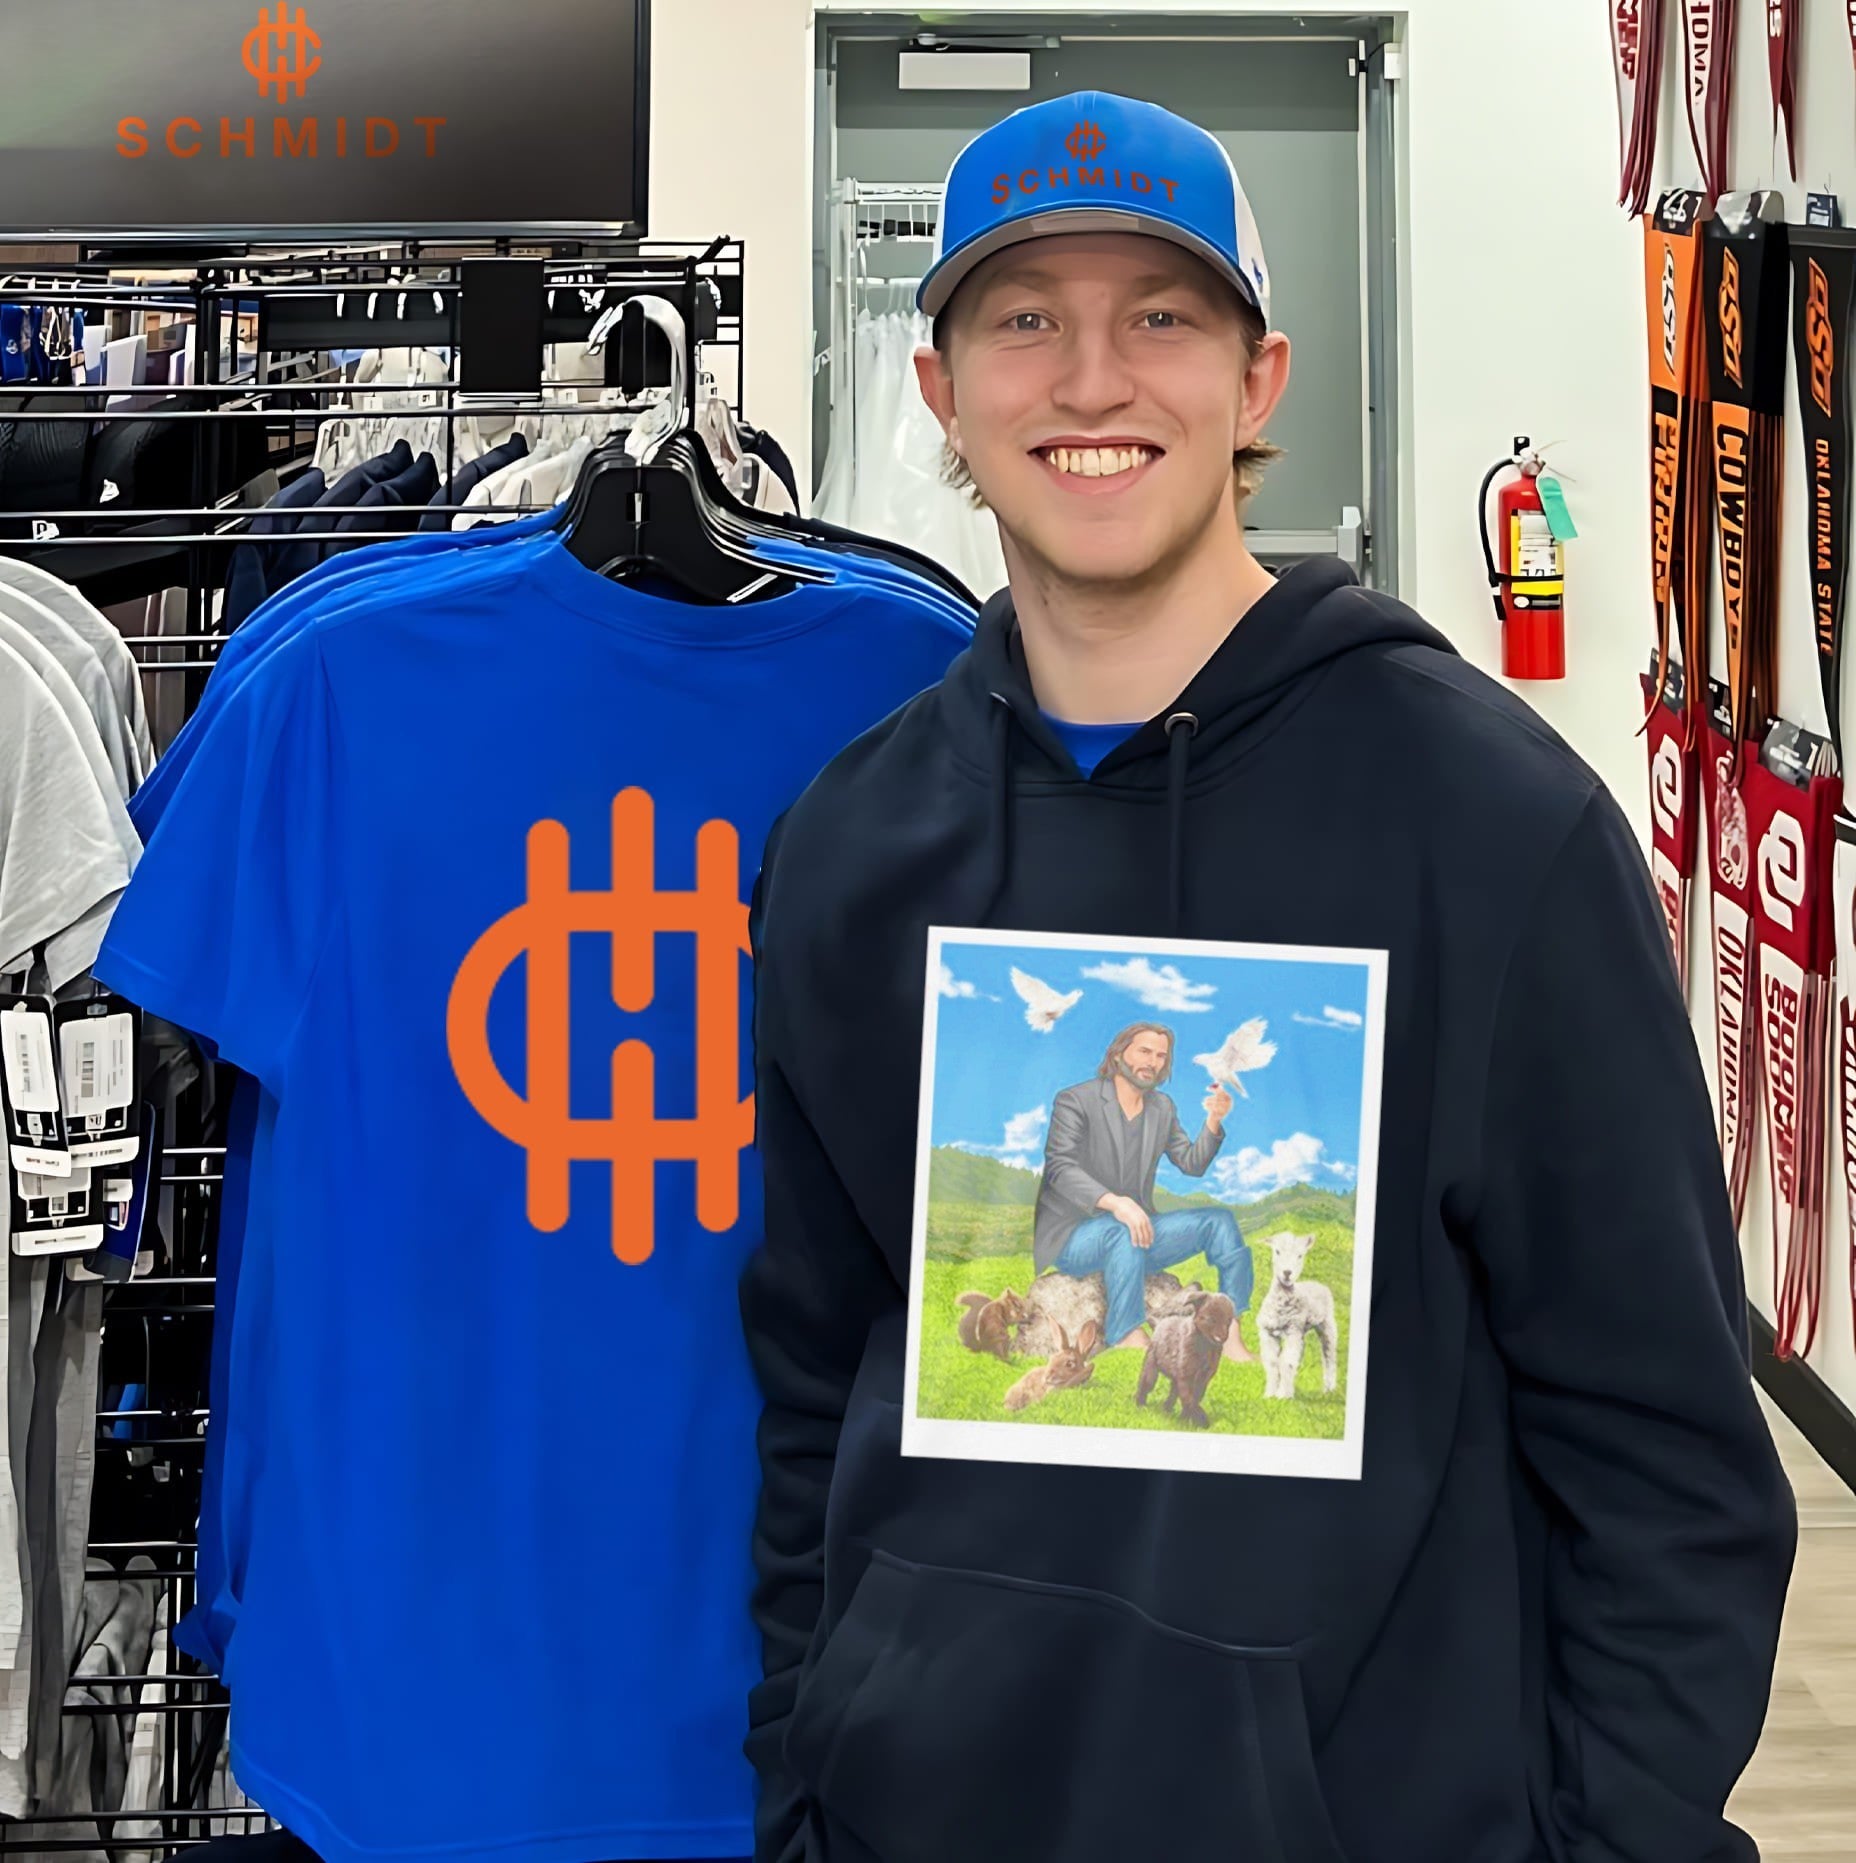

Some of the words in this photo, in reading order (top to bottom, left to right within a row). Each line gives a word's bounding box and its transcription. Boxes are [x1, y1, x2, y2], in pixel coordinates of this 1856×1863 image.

[115, 116, 448, 159] SCHMIDT
[991, 166, 1179, 204] SCHMIDT
[1815, 438, 1832, 571] OKLAHOMA
[1817, 582, 1834, 657] STATE
[1718, 925, 1746, 1145] OKLAHOMA
